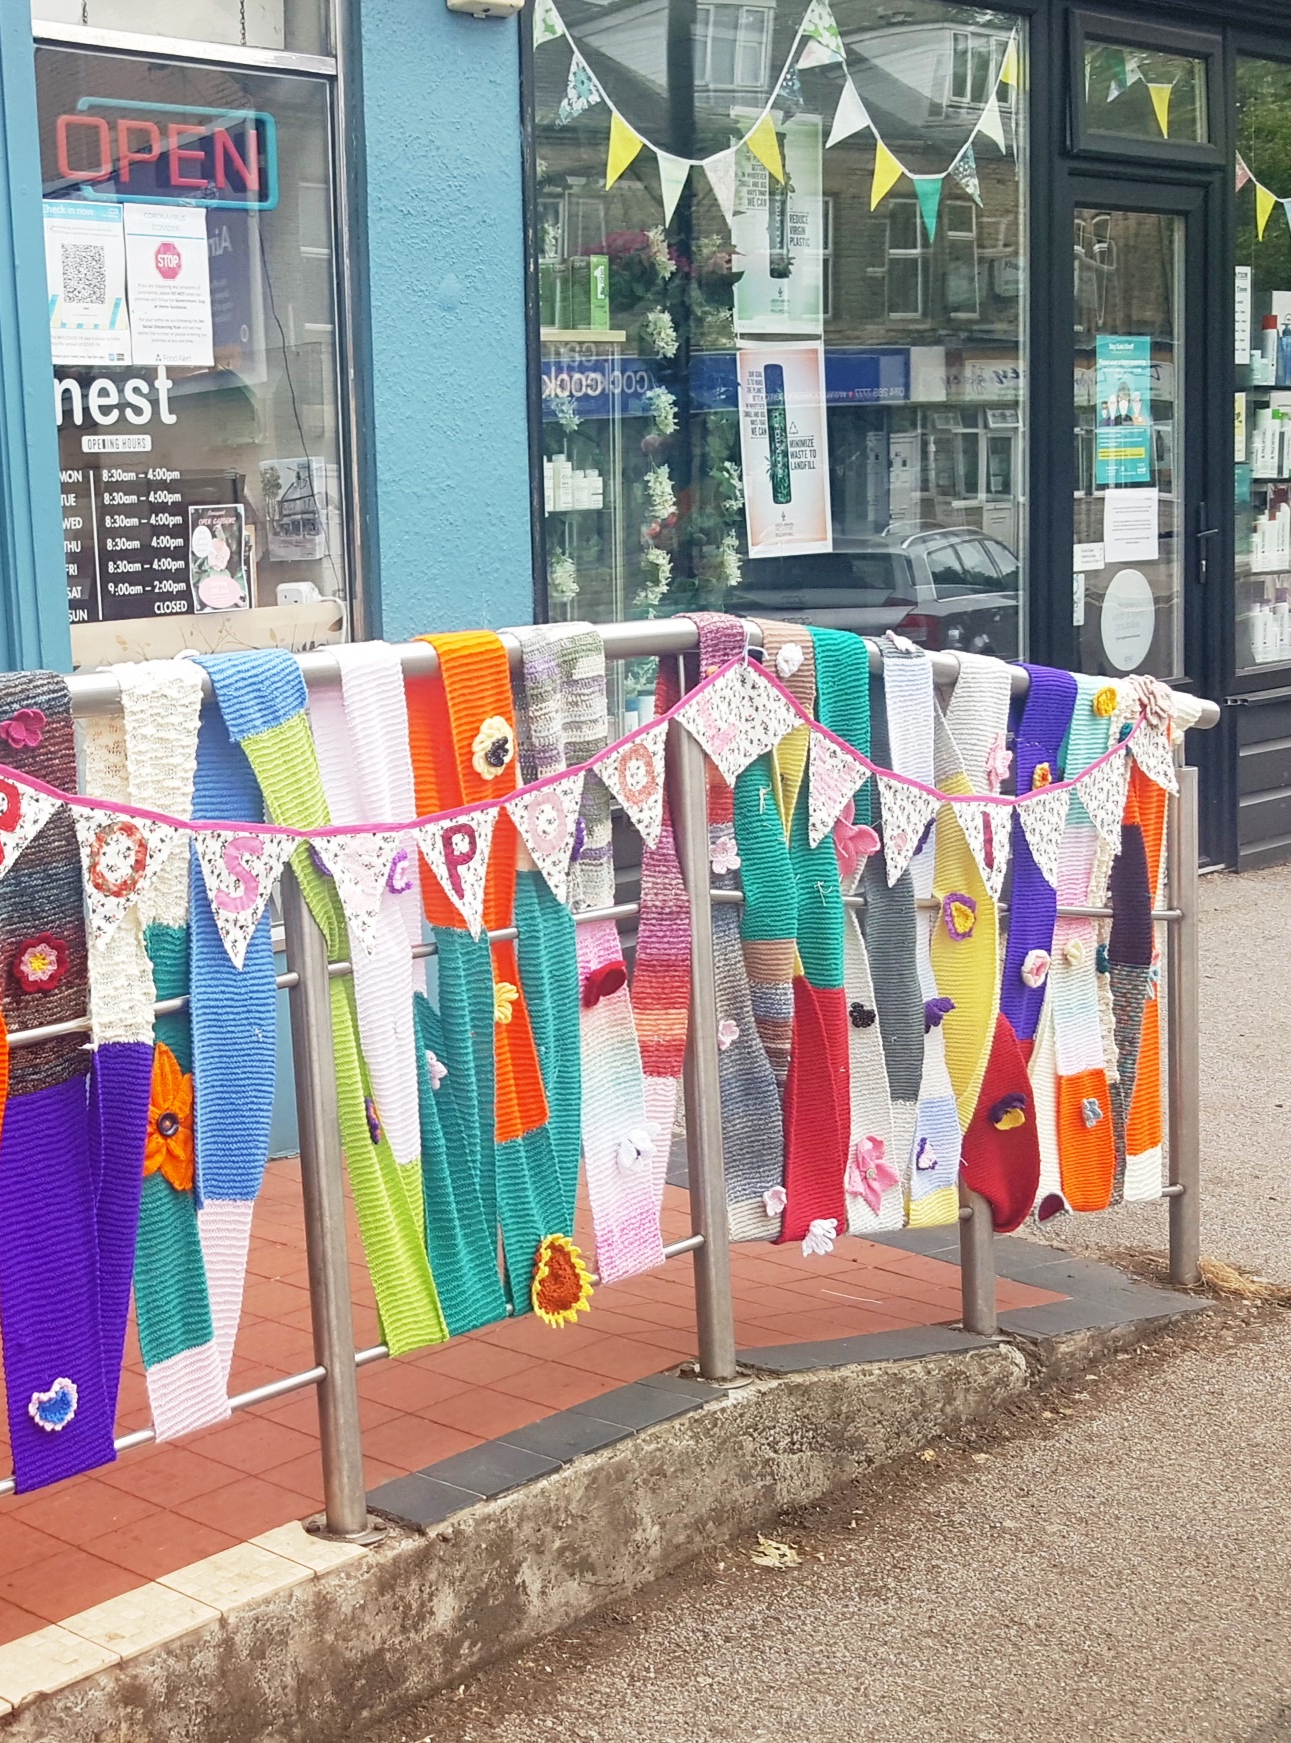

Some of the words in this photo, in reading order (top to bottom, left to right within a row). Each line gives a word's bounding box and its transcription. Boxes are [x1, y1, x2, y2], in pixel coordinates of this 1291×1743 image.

[56, 114, 260, 191] OPEN
[789, 213, 809, 225] REDUCE
[789, 226, 806, 236] VIRGIN
[789, 237, 810, 247] PLASTIC
[157, 254, 179, 268] STOP
[52, 365, 177, 425] nest
[751, 427, 758, 436] WE
[758, 427, 767, 436] CAN
[122, 438, 146, 449] HOURS
[790, 438, 815, 448] MINIMIZE
[790, 450, 808, 459] WASTE
[809, 449, 817, 458] TO
[791, 461, 816, 470] LANDFILL
[59, 470, 83, 482] MON
[102, 470, 136, 482] 8:30am
[147, 468, 180, 483] 4:00pm
[103, 492, 137, 505] 8:30am
[148, 491, 182, 505] 4:00pm
[62, 517, 83, 529] WED
[105, 515, 139, 528] 8:30am
[150, 513, 183, 528] 4:00pm
[106, 538, 140, 550] 8:30am
[151, 536, 184, 550] 4:00pm
[108, 561, 142, 573] 8:30am
[152, 558, 185, 572] 4:00pm
[108, 583, 143, 596] 9:00am
[153, 580, 186, 595] 2:00pm
[154, 601, 188, 614] CLOSED
